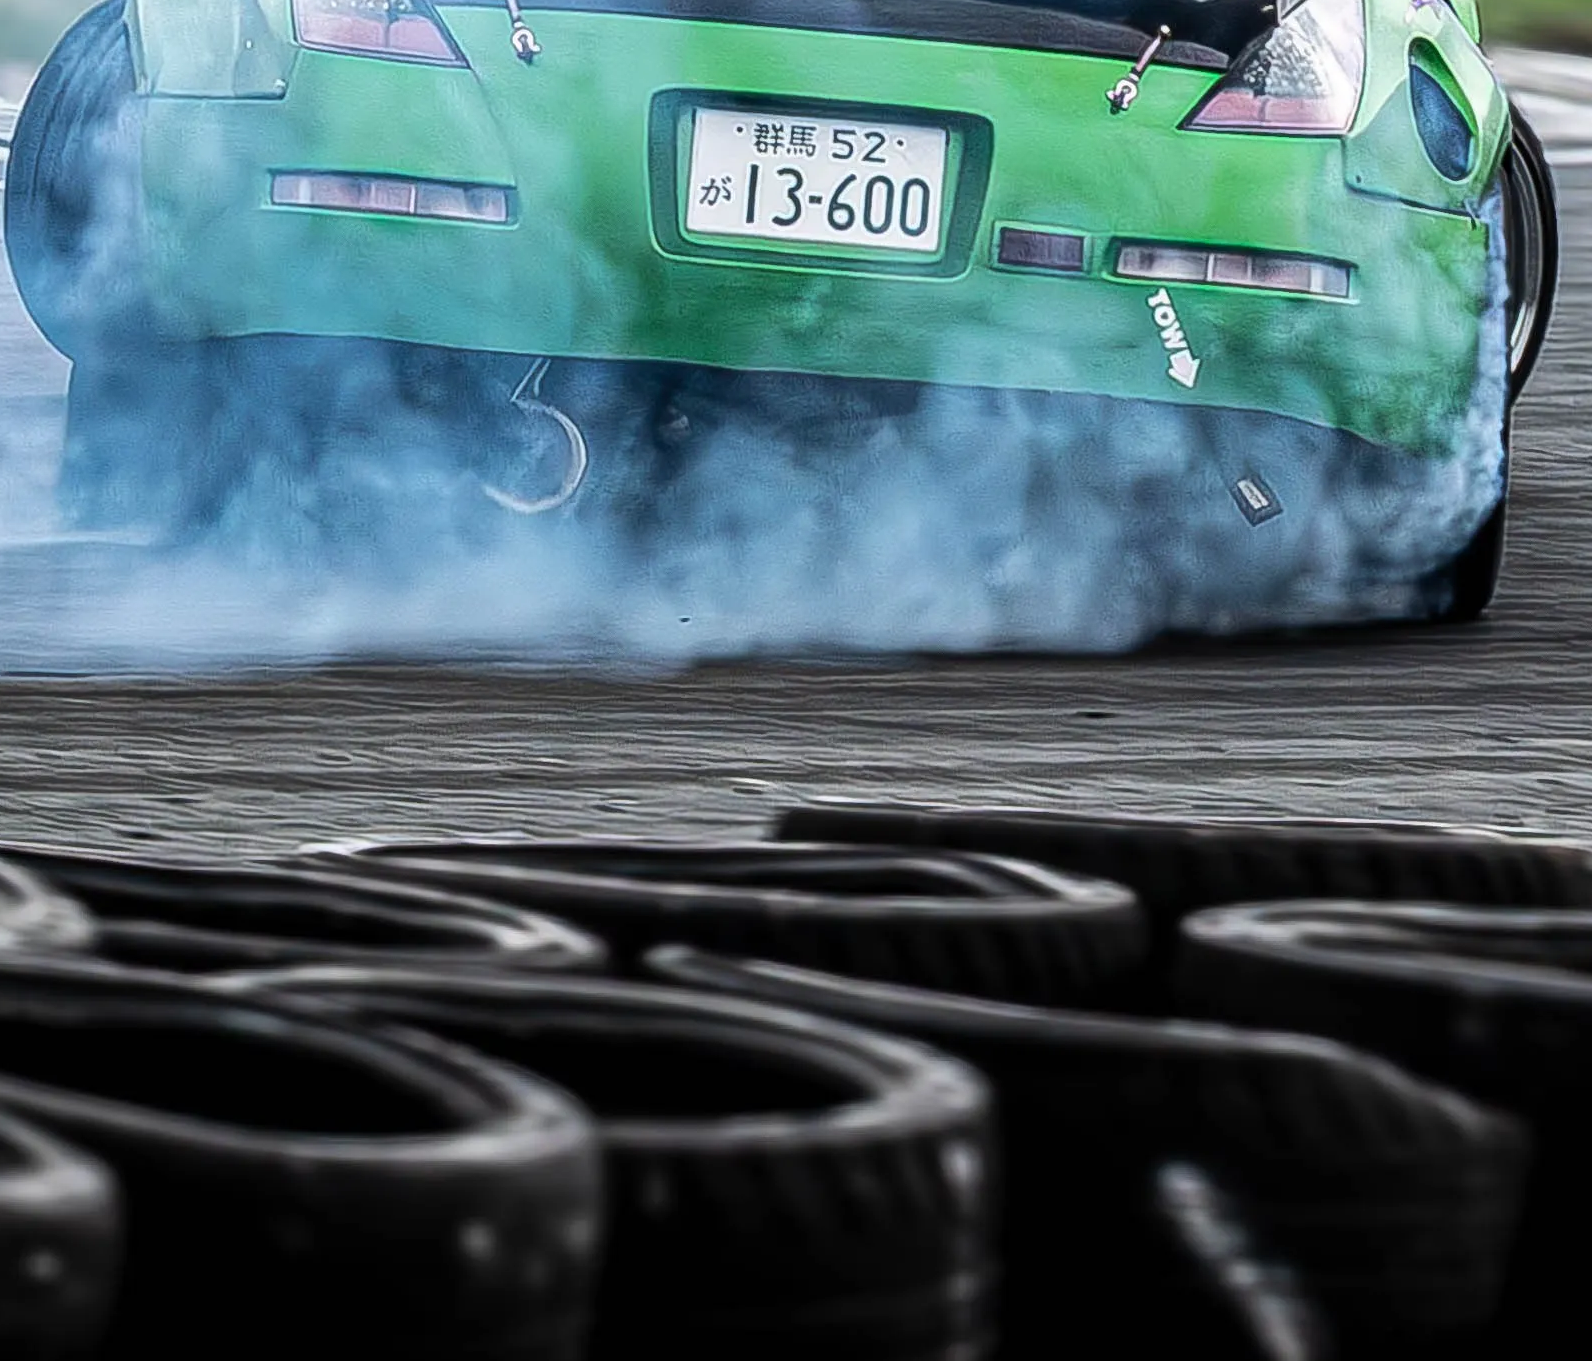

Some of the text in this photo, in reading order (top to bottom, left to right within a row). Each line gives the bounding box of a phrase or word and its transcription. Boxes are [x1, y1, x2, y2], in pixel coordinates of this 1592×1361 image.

[754, 122, 886, 163] 群馬 52
[699, 164, 930, 237] が 13-600
[1147, 288, 1188, 349] TOW
